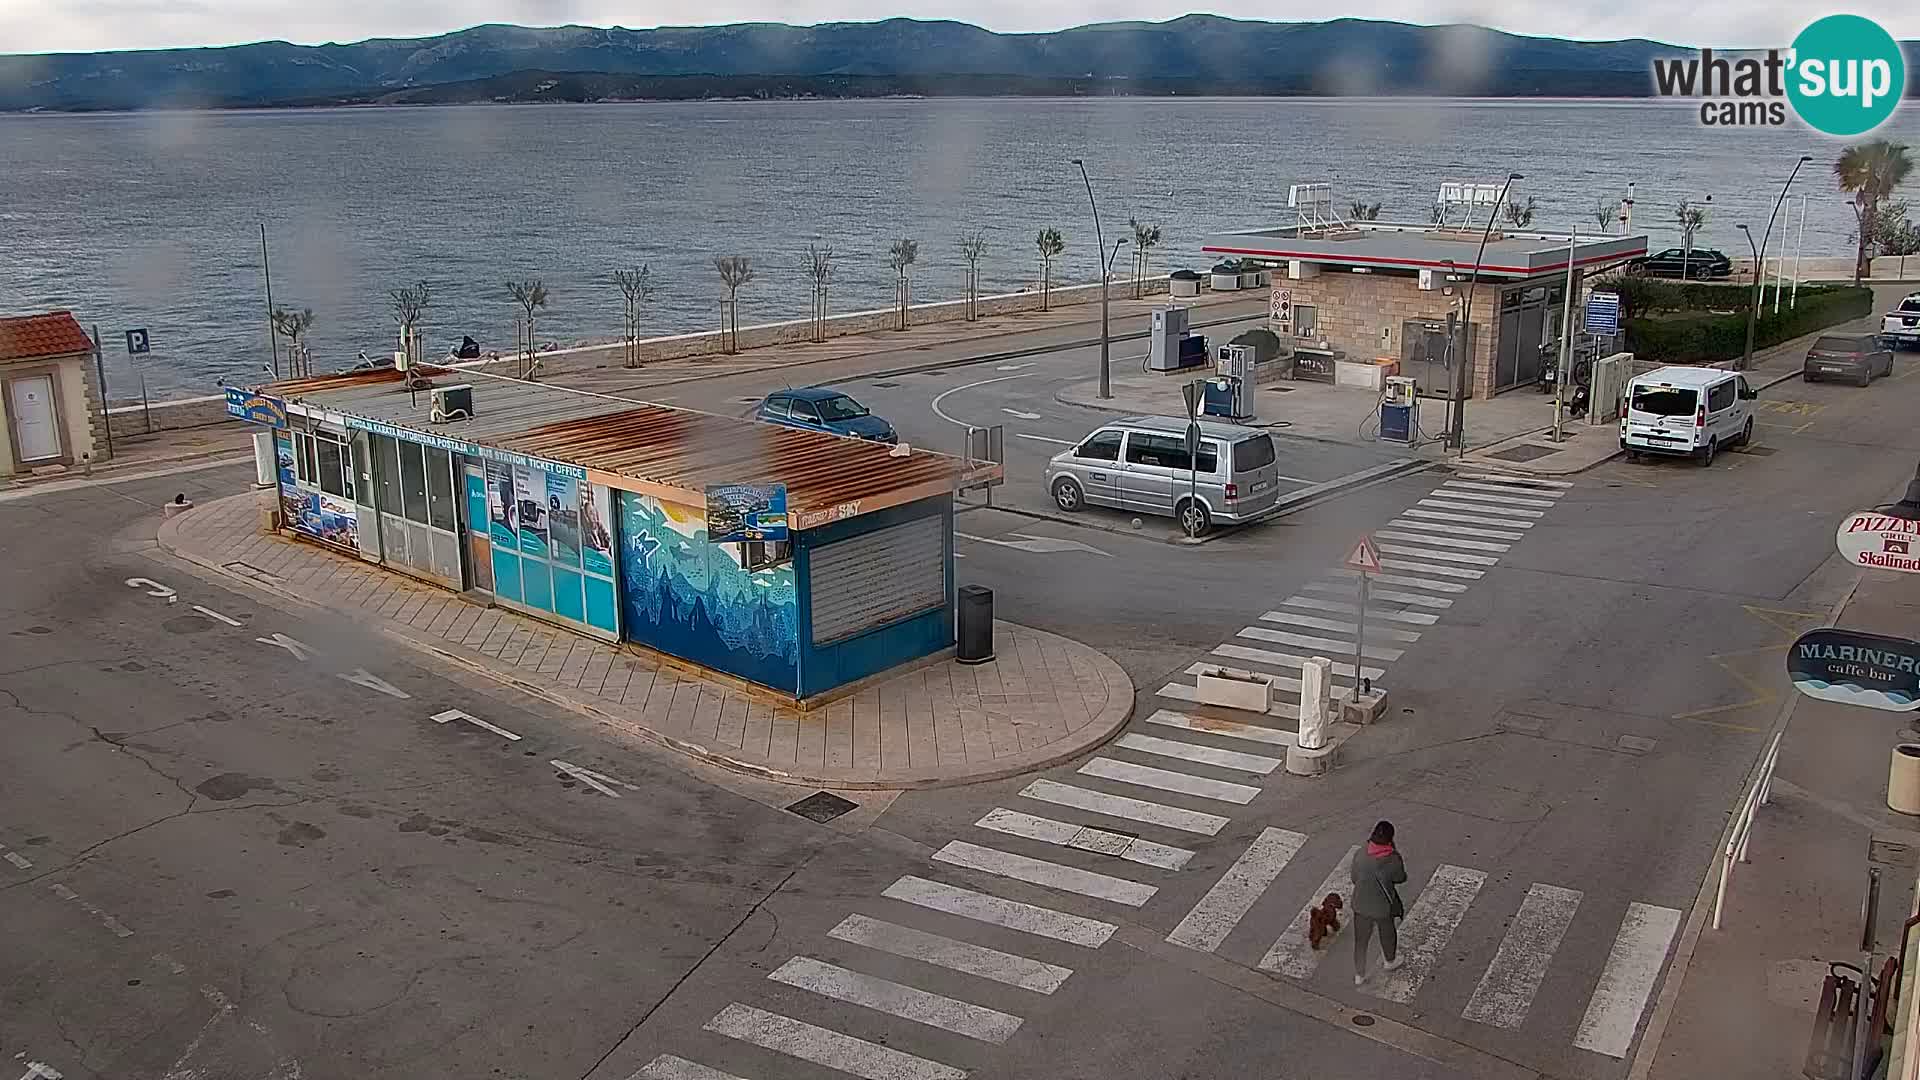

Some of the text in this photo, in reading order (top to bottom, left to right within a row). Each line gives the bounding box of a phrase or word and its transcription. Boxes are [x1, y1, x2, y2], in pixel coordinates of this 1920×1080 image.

[397, 428, 437, 447] AUTOBUSNA
[437, 438, 468, 453] POSTAJA
[478, 446, 494, 459] BUS
[495, 449, 527, 467] STATION
[529, 458, 555, 473] TICKET
[555, 464, 583, 479] OFFICE
[1880, 532, 1916, 543] GRILL
[1827, 663, 1897, 681] caffe bar
